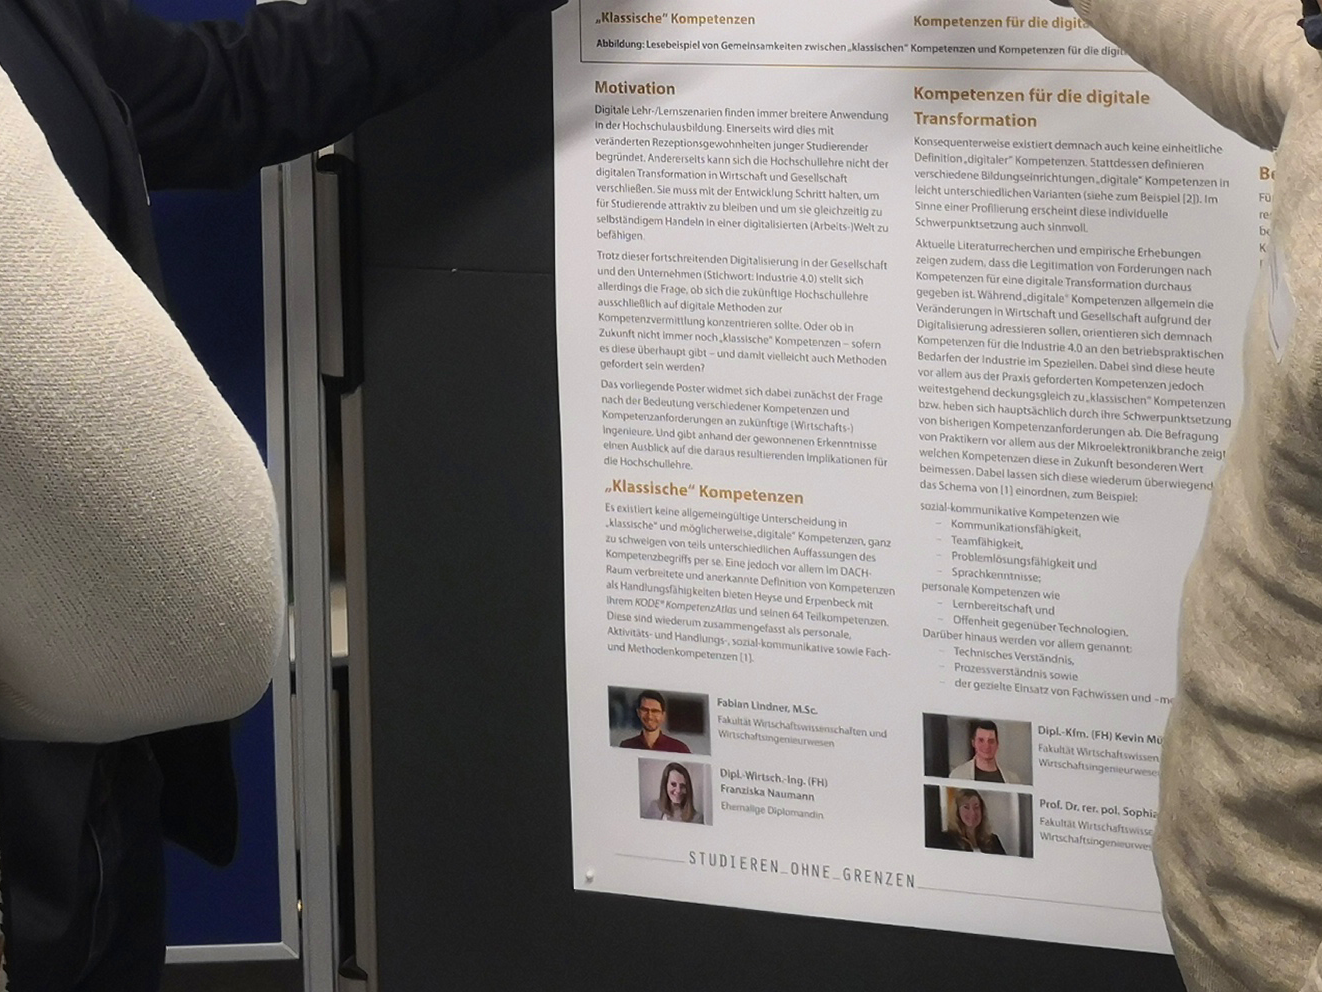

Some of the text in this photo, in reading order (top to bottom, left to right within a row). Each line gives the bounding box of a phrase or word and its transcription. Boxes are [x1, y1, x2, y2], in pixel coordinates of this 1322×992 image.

[596, 12, 755, 26] „Klassische“ Kompetenzen
[914, 15, 1003, 29] Kompetenzen
[1006, 16, 1025, 28] für
[1028, 17, 1048, 28] die
[597, 40, 645, 50] Abbildung:
[647, 40, 700, 51] Lesebeispiel
[702, 42, 719, 50] von
[721, 41, 802, 51] Gemeinsamkeiten
[805, 42, 847, 52] zwischen
[911, 44, 975, 54] Kompetenzen
[978, 44, 997, 54] und
[999, 45, 1065, 56] Kompetenzen
[1067, 46, 1081, 55] für
[1084, 46, 1099, 56] die
[595, 80, 675, 95] Motivation
[914, 87, 1150, 107] Kompetenzen für die digitale
[595, 105, 629, 116] Digitale
[725, 108, 755, 118] finden
[757, 108, 788, 119] immer
[790, 108, 827, 120] breitere
[829, 110, 889, 122] Anwendung
[915, 112, 1037, 127] Transformation
[605, 479, 804, 504] „Klassische“ Kompetenzen
[920, 502, 1119, 522] sozial-kommunikative Kompetenzen wie
[951, 519, 1082, 538] Kommunikationsfähigkeit,
[717, 698, 749, 709] Fabian
[751, 700, 790, 713] Lindner,
[1092, 730, 1112, 741] (FH)
[1115, 732, 1144, 743] Kevin
[808, 777, 828, 788] (FH)
[720, 784, 815, 801] Franziska Naumann
[767, 806, 824, 820] Diplomandin
[1040, 799, 1062, 809] Prof.
[1065, 802, 1079, 811] Dr.
[1083, 804, 1098, 813] rer.
[1101, 806, 1120, 816] pol.
